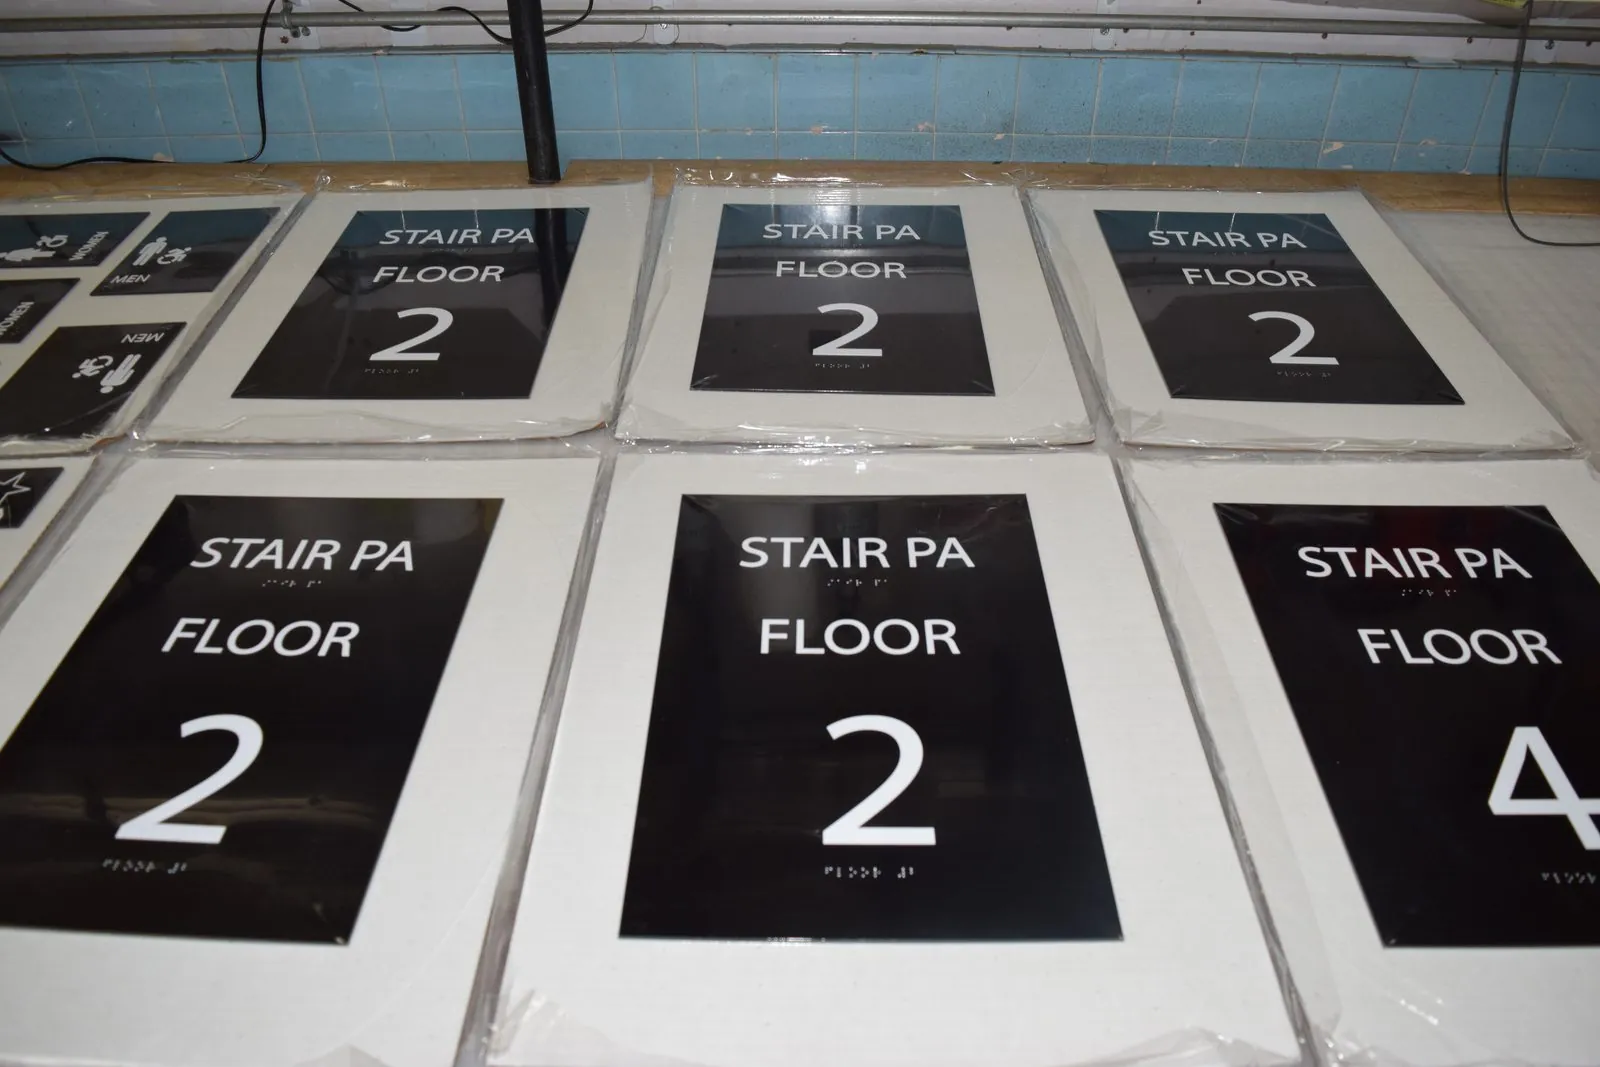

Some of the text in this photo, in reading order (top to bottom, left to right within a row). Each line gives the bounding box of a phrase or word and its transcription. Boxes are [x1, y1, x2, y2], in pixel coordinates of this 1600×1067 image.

[69, 231, 109, 261] WOMEN
[379, 228, 534, 245] STAIR PA
[762, 223, 921, 240] STAIR PA
[1148, 230, 1307, 249] STAIR PA
[109, 273, 151, 284] MEN
[372, 266, 505, 283] FLOOR
[776, 260, 907, 279] FLOOR
[1181, 268, 1316, 287] FLOOR
[121, 332, 165, 343] MEN
[369, 308, 454, 361] 2
[813, 303, 882, 357] 2
[1249, 312, 1339, 365] 2
[190, 537, 414, 572] STAIR PA
[739, 536, 976, 569] STAIR PA
[1298, 546, 1533, 579] STAIR PA
[161, 617, 360, 658] FLOOR
[760, 618, 961, 656] FLOOR
[1357, 628, 1562, 665] FLOOR
[115, 714, 264, 845] 2
[821, 714, 937, 847] 2
[1487, 726, 1600, 850] 4
